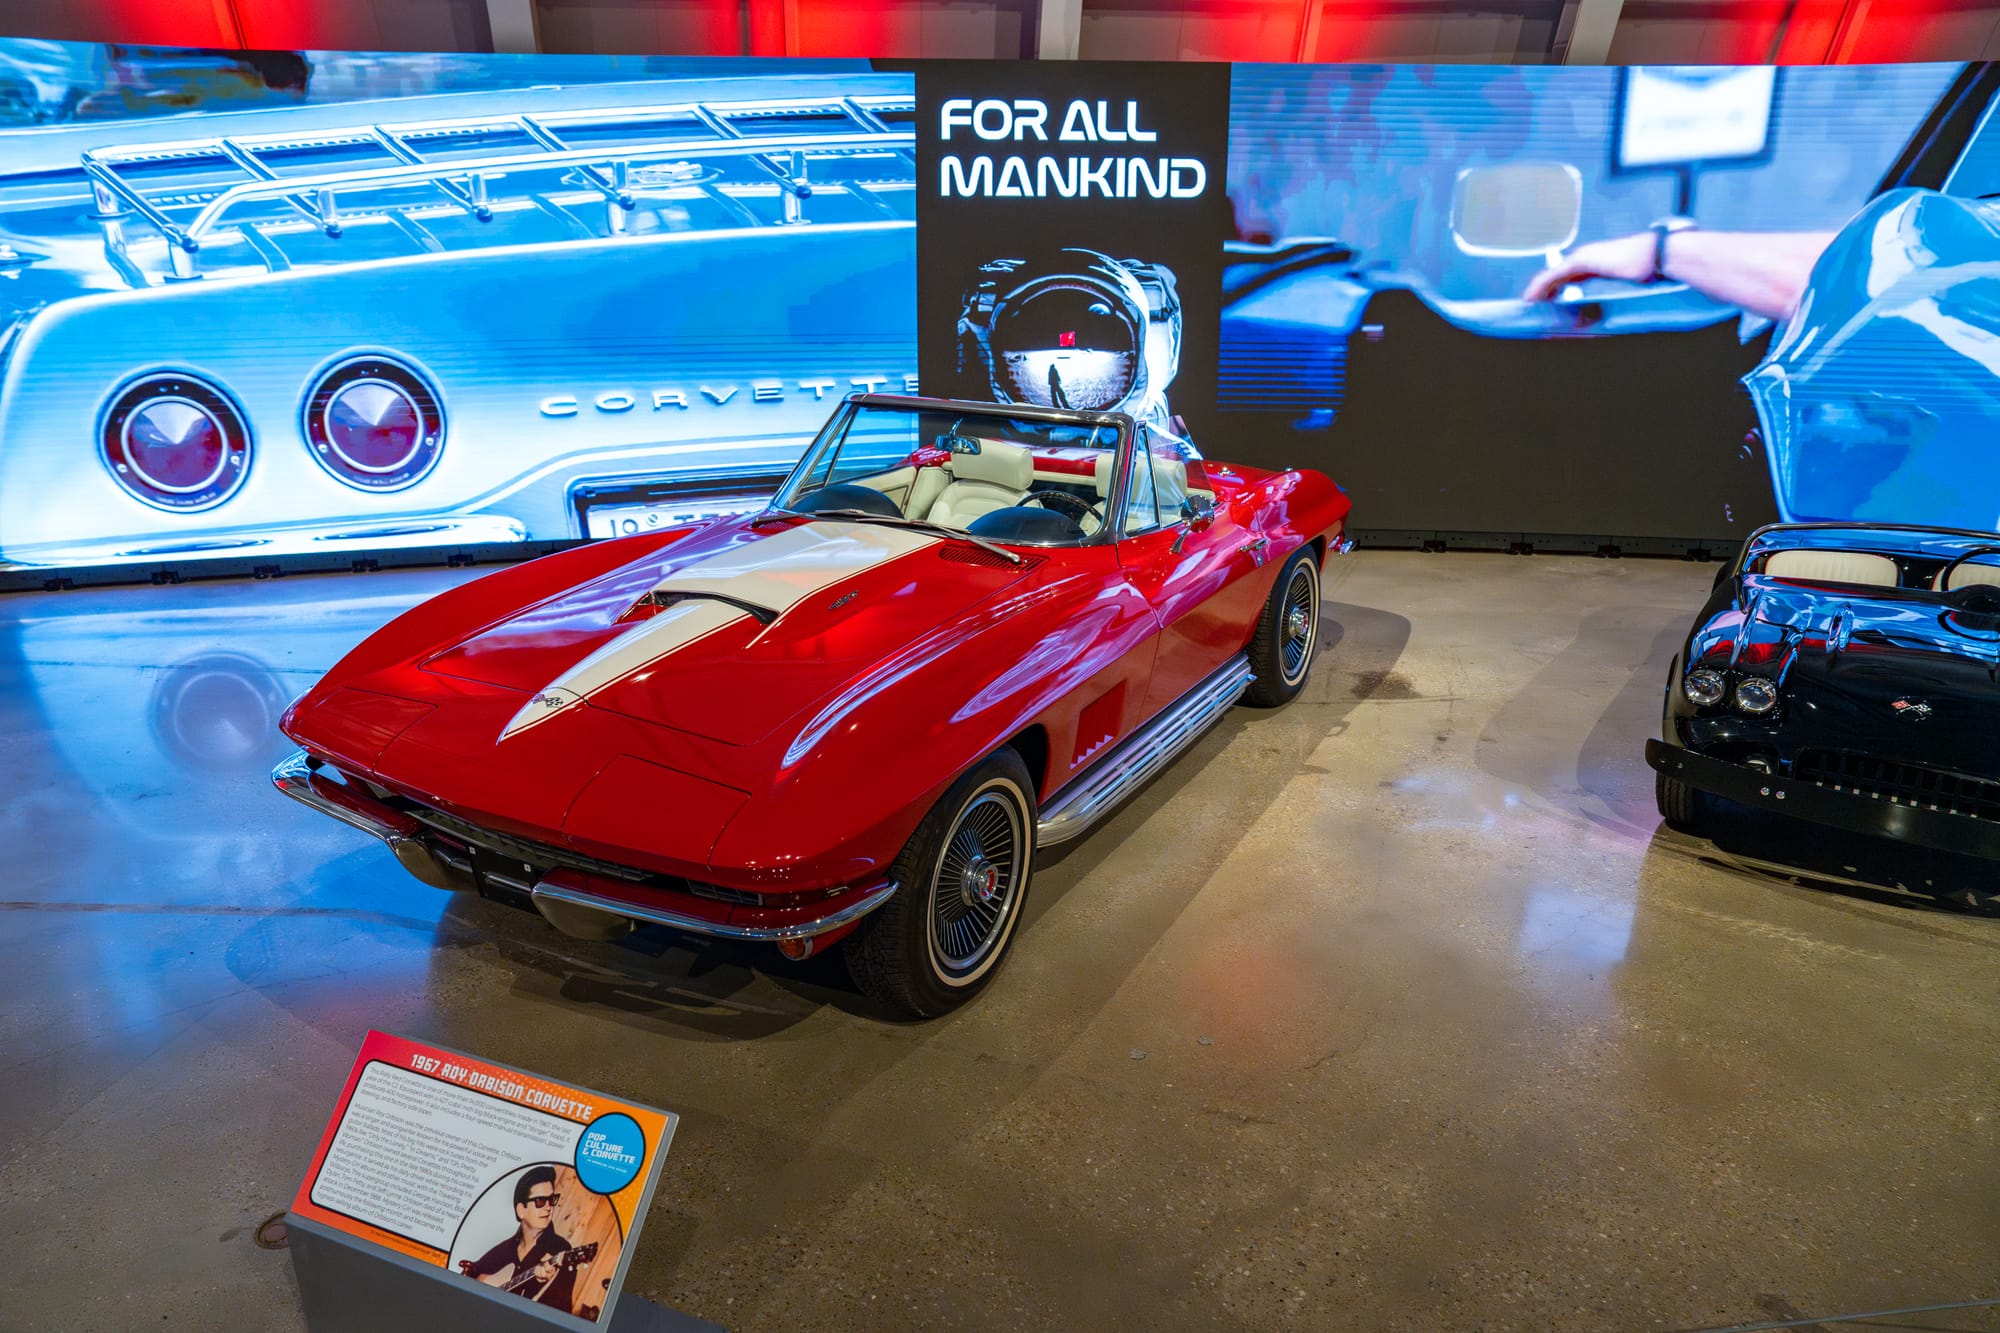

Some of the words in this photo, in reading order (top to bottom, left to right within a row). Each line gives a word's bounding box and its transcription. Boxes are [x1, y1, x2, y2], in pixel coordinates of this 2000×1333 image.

[940, 99, 1048, 140] FOR
[1058, 100, 1157, 142] ALL
[940, 155, 1206, 198] MANKIND
[410, 1054, 442, 1073] 1967
[441, 1063, 468, 1082] ROY
[468, 1070, 525, 1101] ORBISON
[525, 1088, 592, 1120] CORVETTE
[584, 1140, 624, 1153] CULTURE
[588, 1132, 606, 1141] POP
[590, 1149, 636, 1164] CORVETTE
